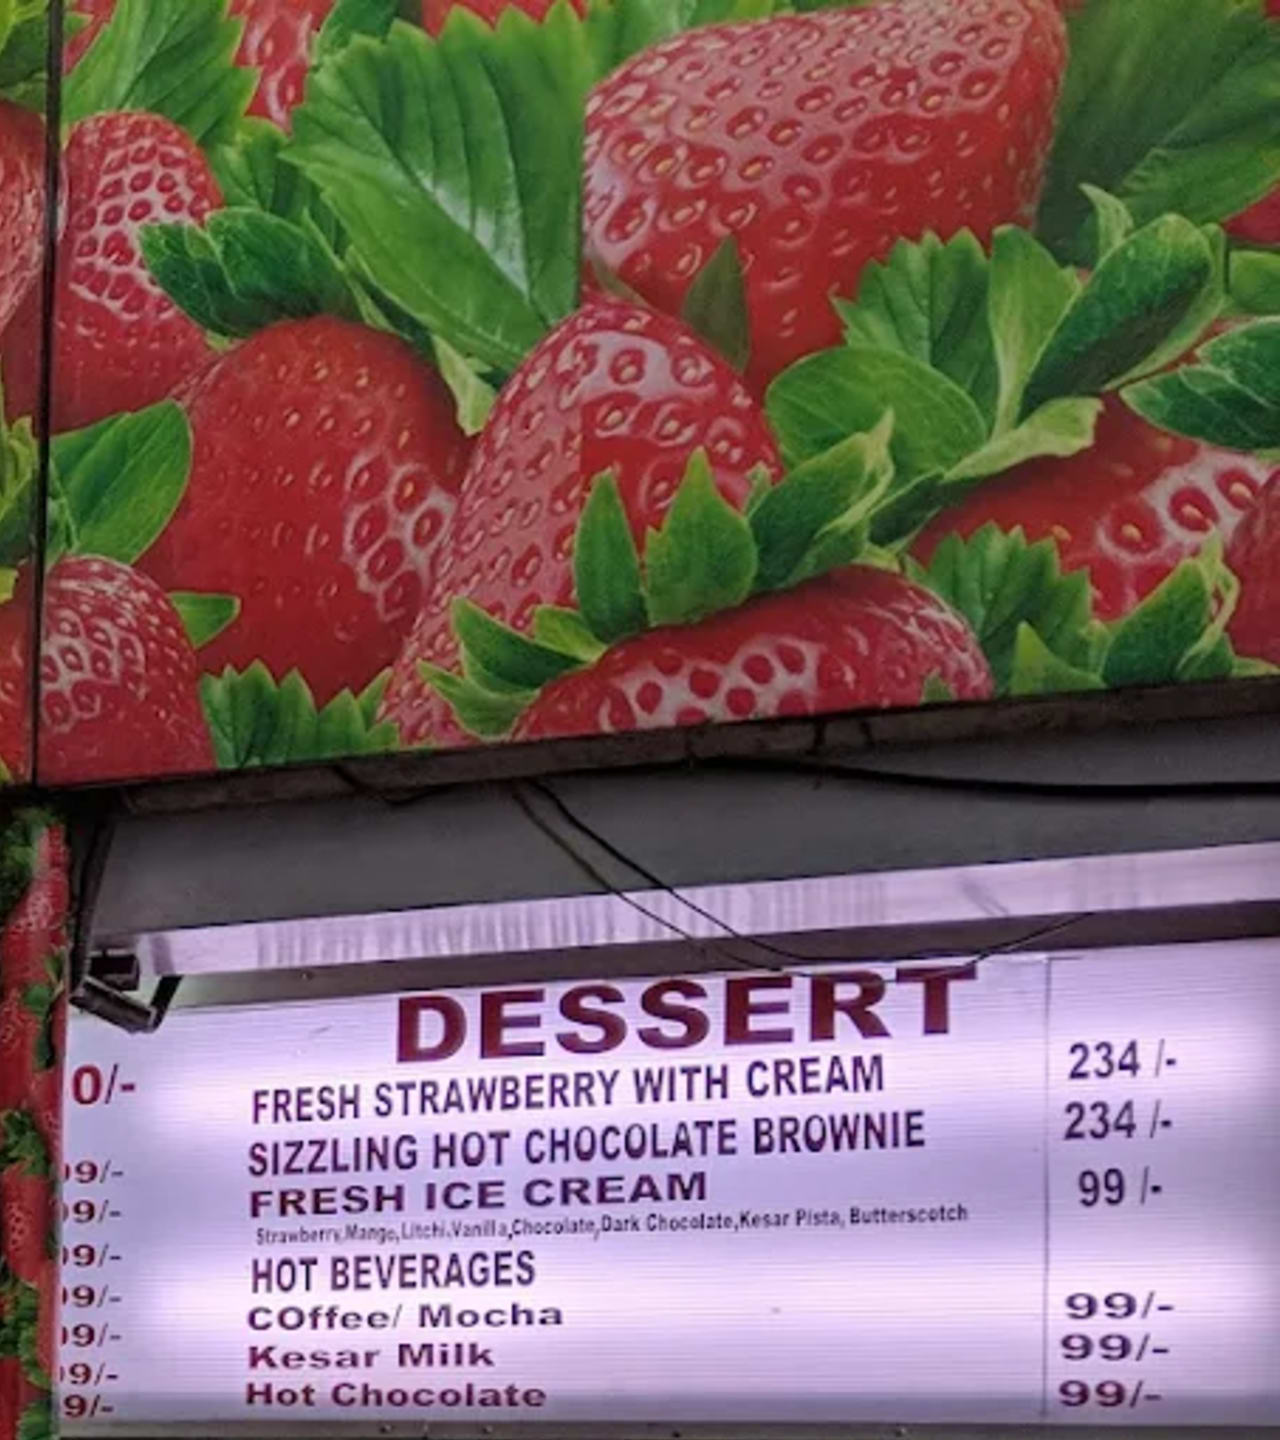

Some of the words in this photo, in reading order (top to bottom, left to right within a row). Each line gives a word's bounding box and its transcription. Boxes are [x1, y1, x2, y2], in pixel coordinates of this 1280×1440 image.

[396, 963, 977, 1064] DESSERT
[253, 1084, 360, 1124] FRESH
[375, 1069, 620, 1117] STRAWBERRY
[633, 1064, 728, 1104] WITH
[746, 1054, 883, 1098] CREAM
[248, 1135, 418, 1177] SIZZLING
[433, 1130, 510, 1169] HOT
[525, 1119, 737, 1165] CHOCOLATE
[753, 1110, 925, 1155] BROWNIE
[64, 1159, 123, 1184] 9/-
[249, 1184, 404, 1218] FRESH
[426, 1180, 505, 1210] ICE
[523, 1171, 706, 1206] CREAM
[61, 1199, 121, 1224] 9/-
[796, 1208, 845, 1228] Pista,
[850, 1204, 968, 1224] Butterscotch
[62, 1243, 121, 1268] 9/-
[251, 1257, 318, 1293] HOT
[331, 1250, 536, 1291] BEVERAGES
[62, 1284, 121, 1308] 9/-
[1066, 1291, 1174, 1319] 99/-
[418, 1302, 563, 1328] Mocha
[61, 1323, 121, 1348] 9/-
[1061, 1333, 1169, 1361] 99/-
[248, 1345, 380, 1370] Kesar
[398, 1342, 494, 1368] Milk
[59, 1362, 118, 1386] 9/-
[246, 1382, 316, 1407] Hot
[331, 1382, 546, 1407] Chocolate
[1059, 1380, 1162, 1408] 99/-
